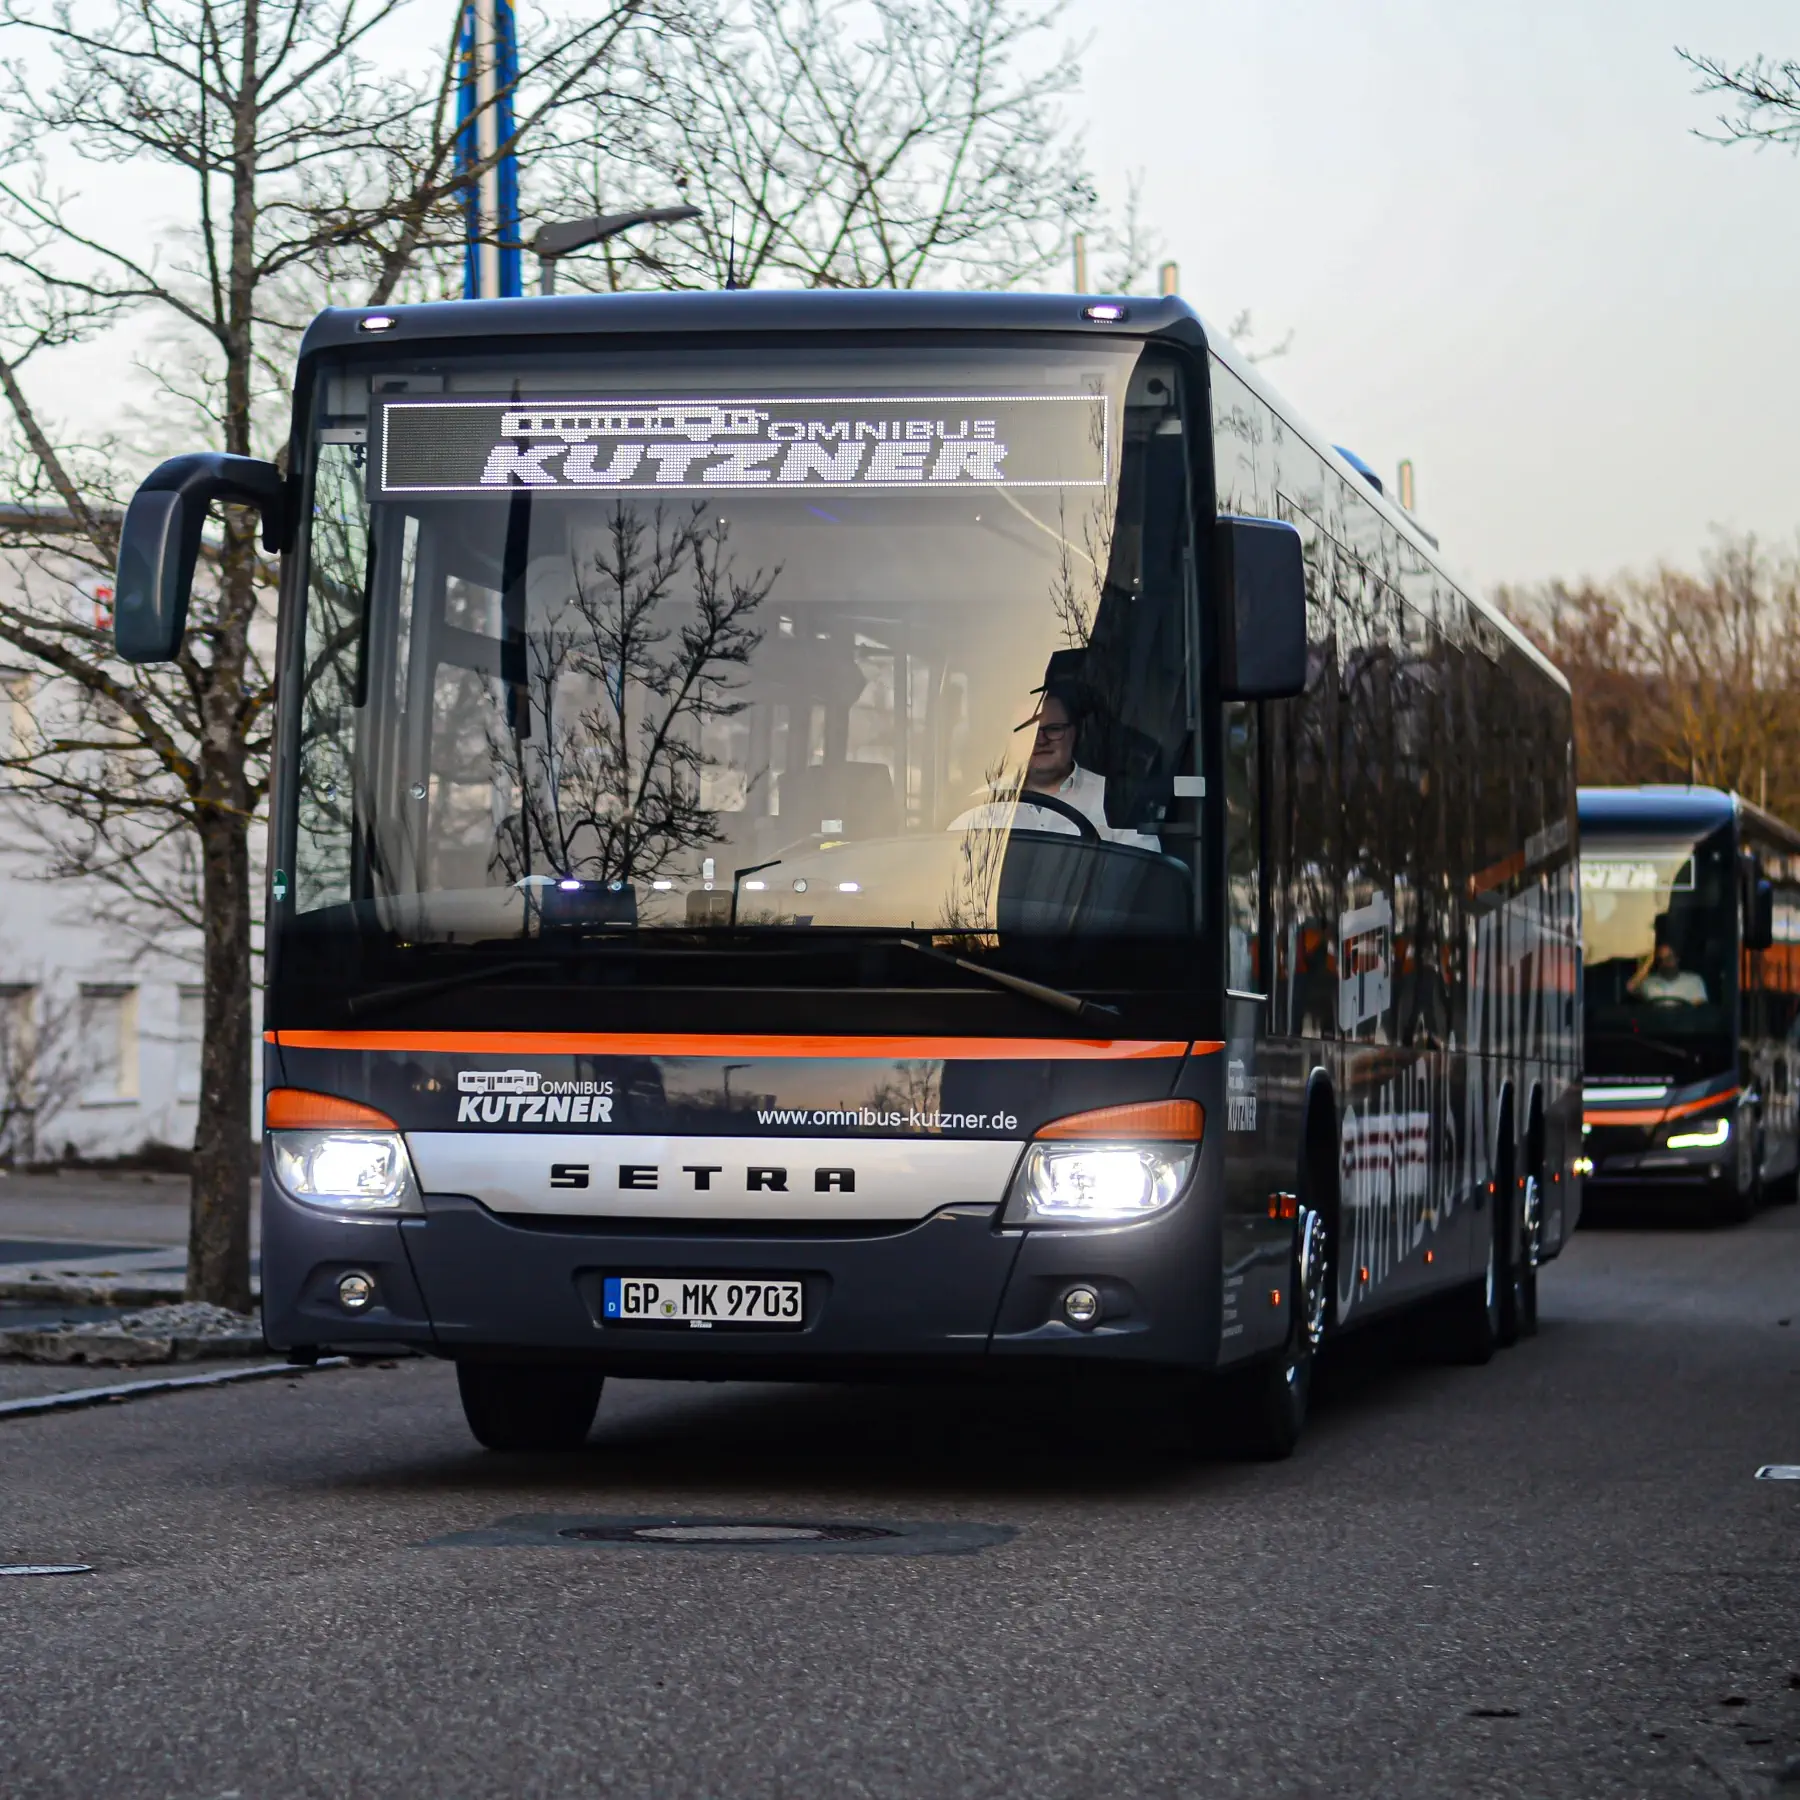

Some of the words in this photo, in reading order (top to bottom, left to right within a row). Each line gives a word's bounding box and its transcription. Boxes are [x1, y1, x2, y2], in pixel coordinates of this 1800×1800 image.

[768, 420, 996, 441] OMNIBUS
[480, 441, 1008, 483] KUTZNER
[541, 1081, 613, 1095] OMNIBUS
[457, 1096, 613, 1123] KUTZNER
[757, 1107, 1018, 1130] www.omnibus-kutzner.de
[550, 1163, 856, 1193] SETRA
[624, 1282, 660, 1314] GP
[682, 1284, 718, 1316] MK
[727, 1285, 799, 1317] 9703
